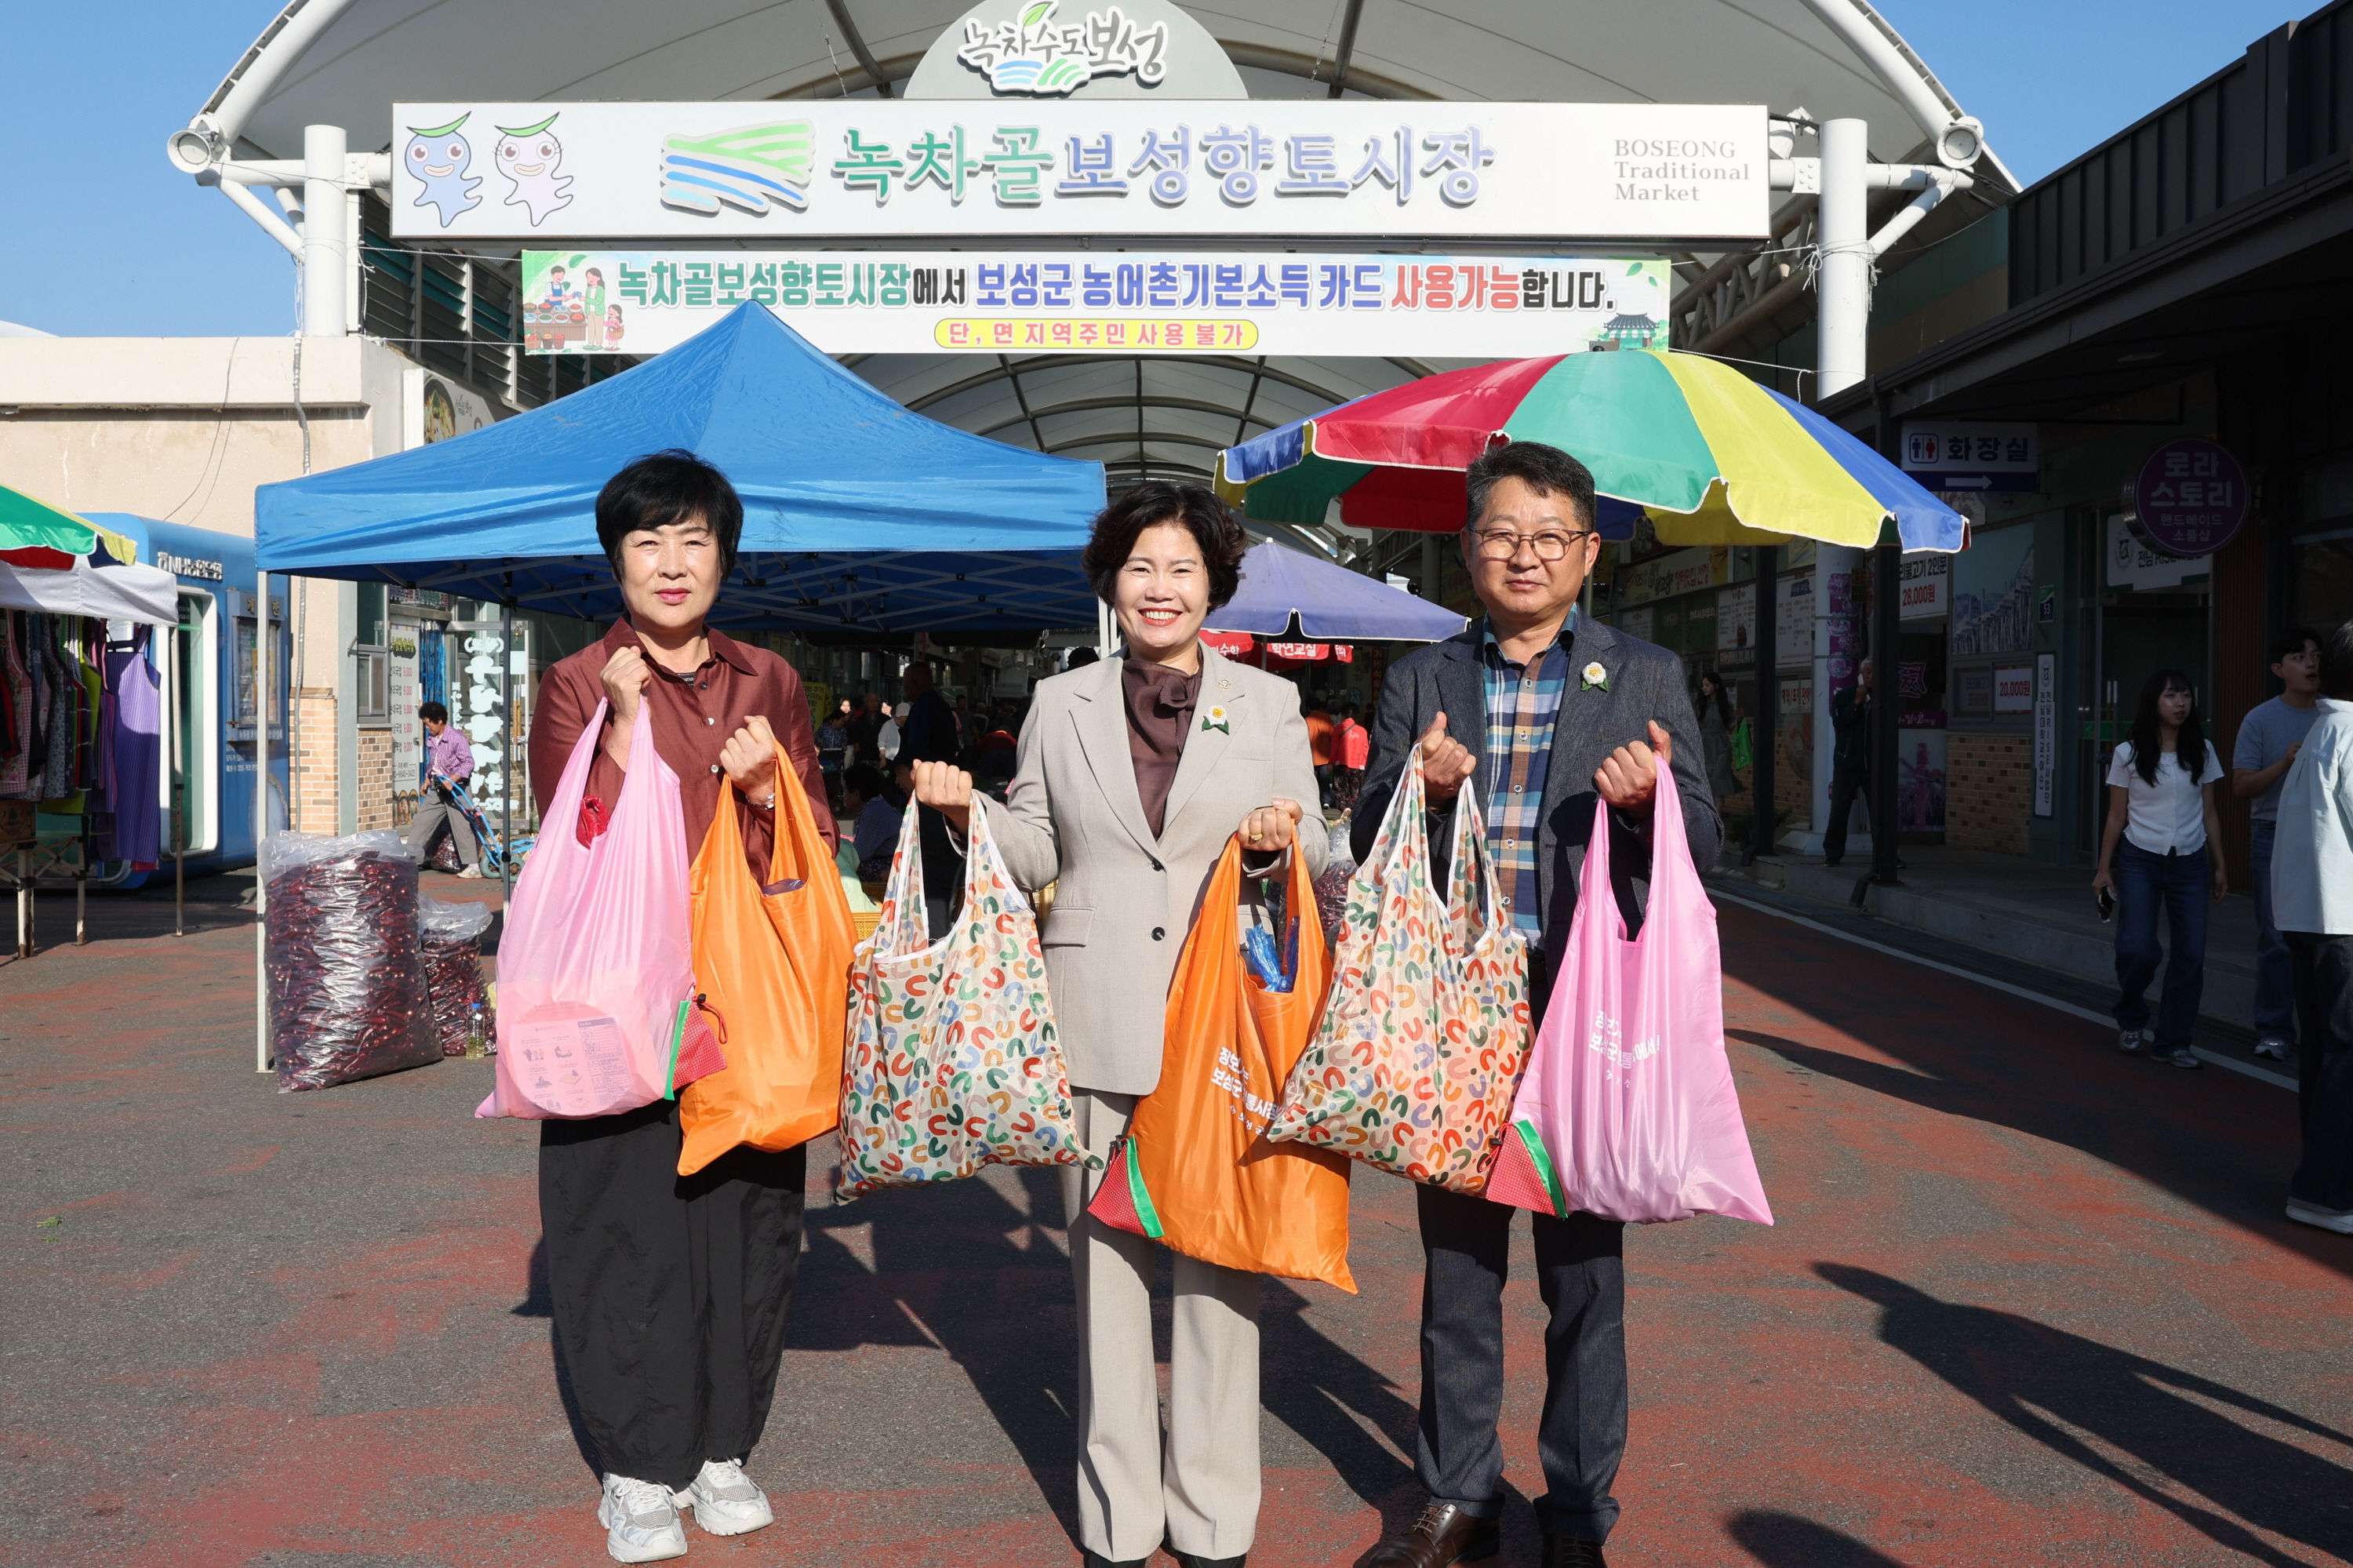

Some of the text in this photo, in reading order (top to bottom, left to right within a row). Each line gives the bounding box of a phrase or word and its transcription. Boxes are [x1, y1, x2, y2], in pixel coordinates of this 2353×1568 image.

[1614, 139, 1736, 158] BOSEONG
[1614, 161, 1750, 180] Traditional
[1614, 183, 1701, 202] Market
[620, 262, 1613, 310] 녹차골보성향토시장에서 보성군 농어촌기본소득 카드 사용가능합니다.
[950, 322, 1243, 347] 단, 면 지역주민 사용 불가
[1947, 437, 2028, 461] 화장실
[2164, 451, 2220, 478] 로라
[2150, 480, 2232, 508] 스토리
[2160, 514, 2224, 526] 핸드메이드
[168, 555, 223, 580] NH농협은행
[1928, 555, 1947, 577] 2인분
[2138, 550, 2154, 568] 전남
[1903, 584, 1935, 608] 28,000원
[2043, 603, 2051, 615] 53
[1999, 680, 2031, 699] 20,000원
